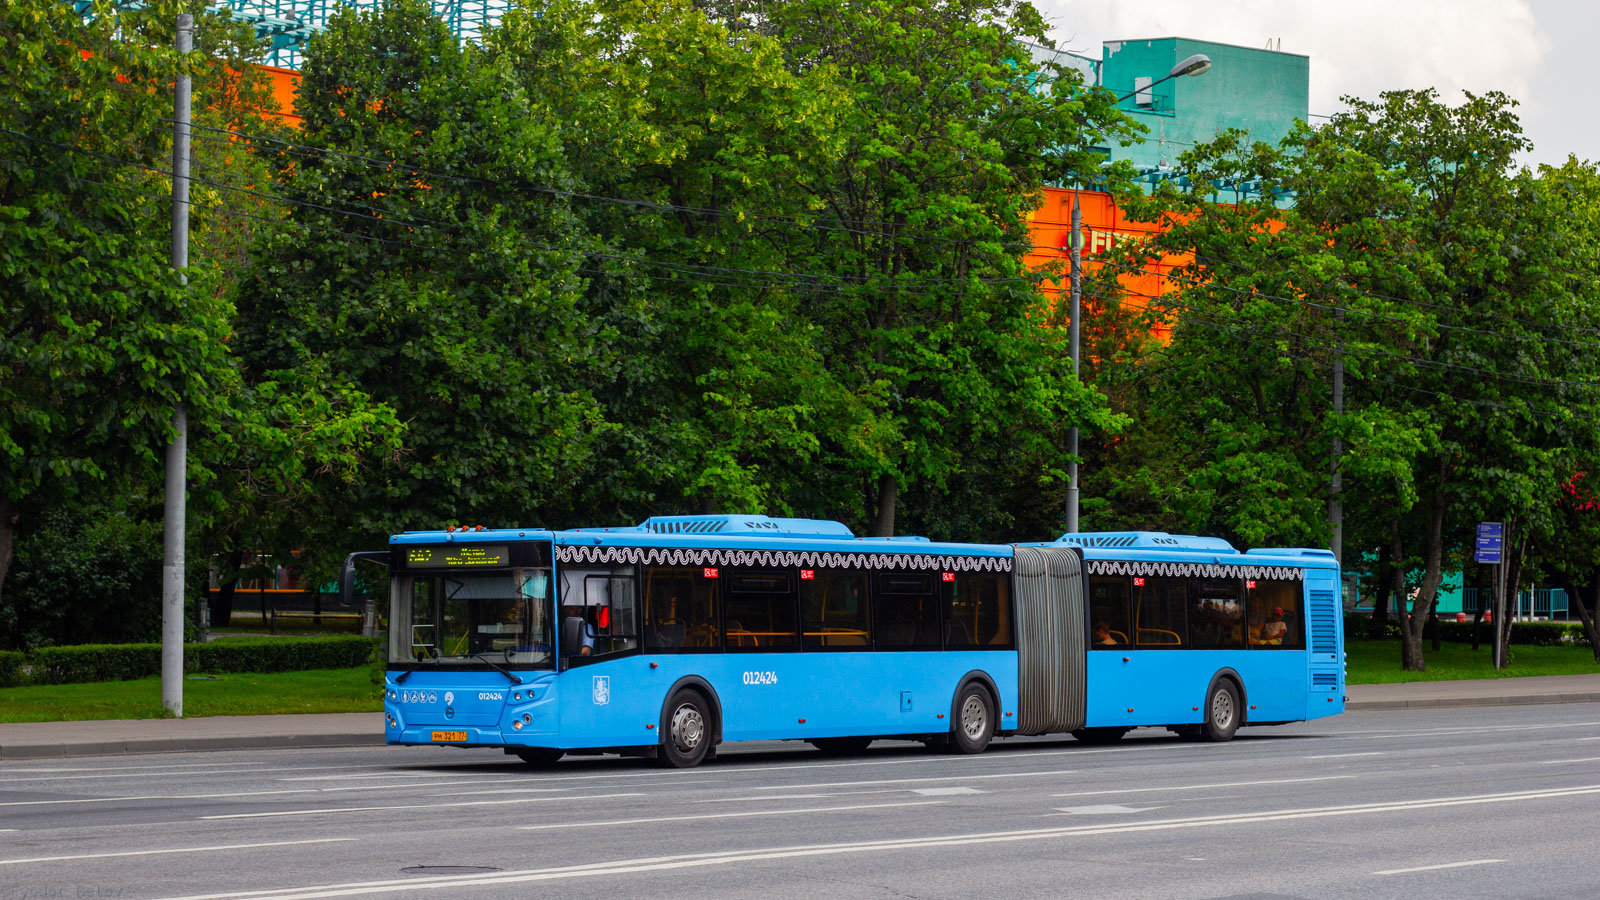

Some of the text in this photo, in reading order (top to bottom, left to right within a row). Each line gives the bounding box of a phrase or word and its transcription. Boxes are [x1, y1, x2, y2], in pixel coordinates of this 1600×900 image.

[743, 671, 777, 684] 012424
[478, 692, 502, 700] 012424
[444, 732, 455, 740] 321
